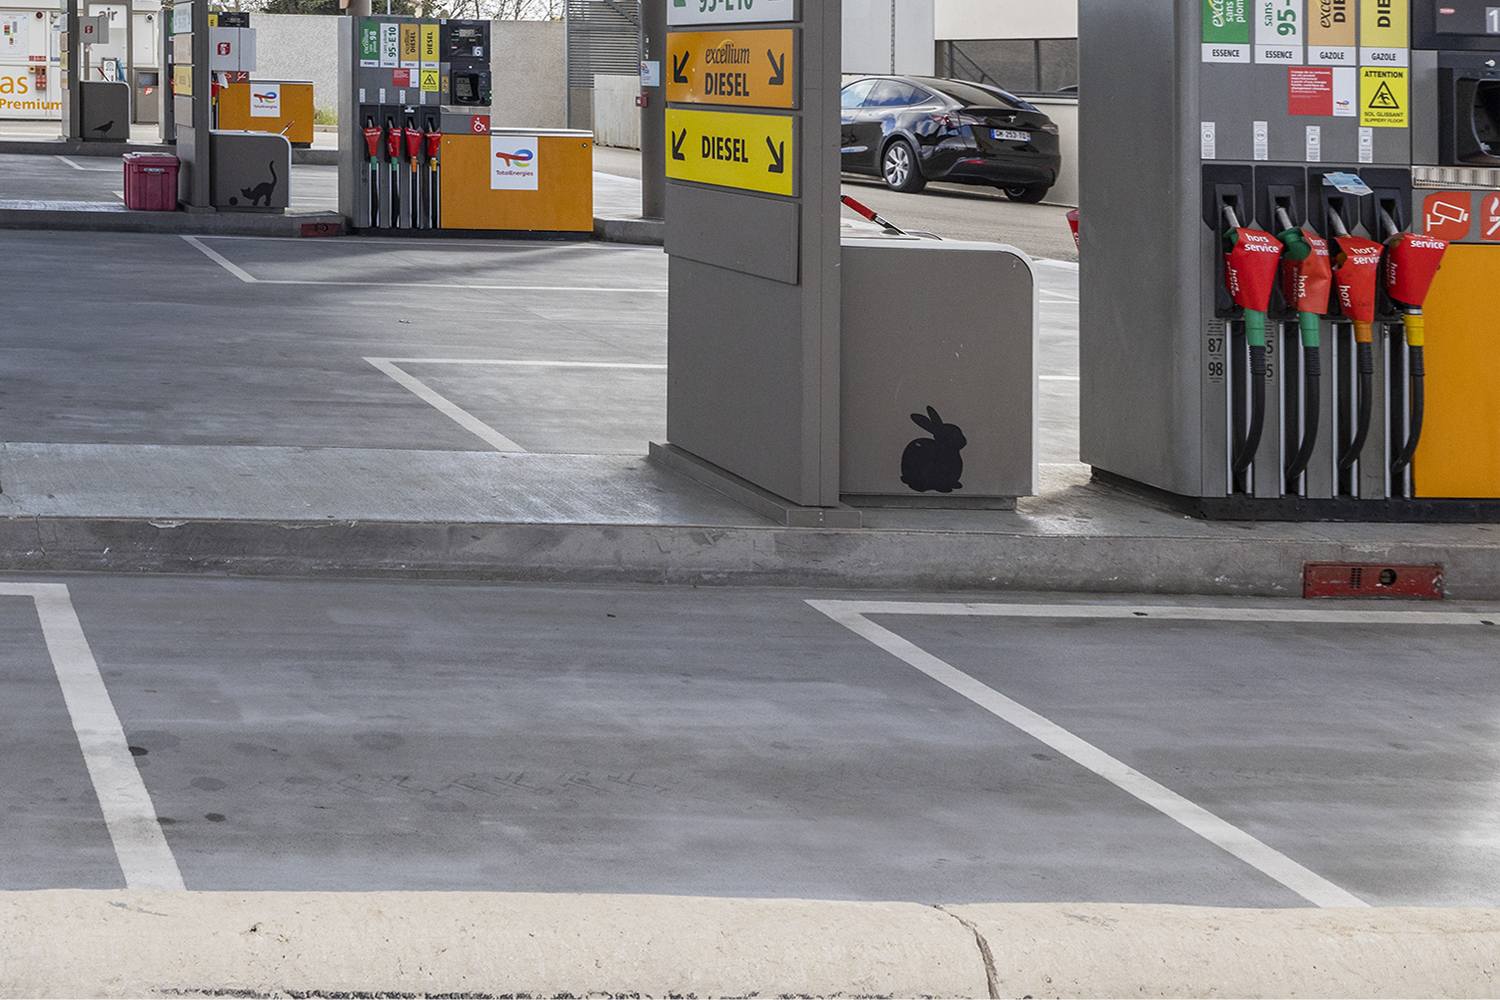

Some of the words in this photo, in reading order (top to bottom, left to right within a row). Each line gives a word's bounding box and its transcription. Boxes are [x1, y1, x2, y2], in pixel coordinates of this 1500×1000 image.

[98, 7, 118, 22] air
[1226, 1, 1234, 22] sans
[1264, 2, 1273, 26] sans
[370, 30, 377, 40] 98
[388, 26, 396, 58] 95-E10
[474, 48, 482, 56] 6
[705, 44, 750, 64] excellium
[1212, 49, 1240, 58] ESSENCE
[1266, 50, 1292, 59] ESSENCE
[1320, 52, 1344, 60] GAZOLE
[1372, 52, 1396, 61] GAZOLE
[1364, 70, 1404, 78] ATTENTION
[705, 72, 750, 97] DIESEL
[702, 136, 748, 164] DIESEL
[1245, 233, 1269, 242] hors
[1244, 244, 1279, 254] service
[1350, 246, 1378, 254] hors
[1410, 240, 1444, 250] service
[1390, 262, 1398, 284] hors
[1298, 275, 1308, 298] hors
[1339, 285, 1352, 308] hors
[1208, 338, 1222, 352] 87
[1208, 362, 1223, 376] 98
